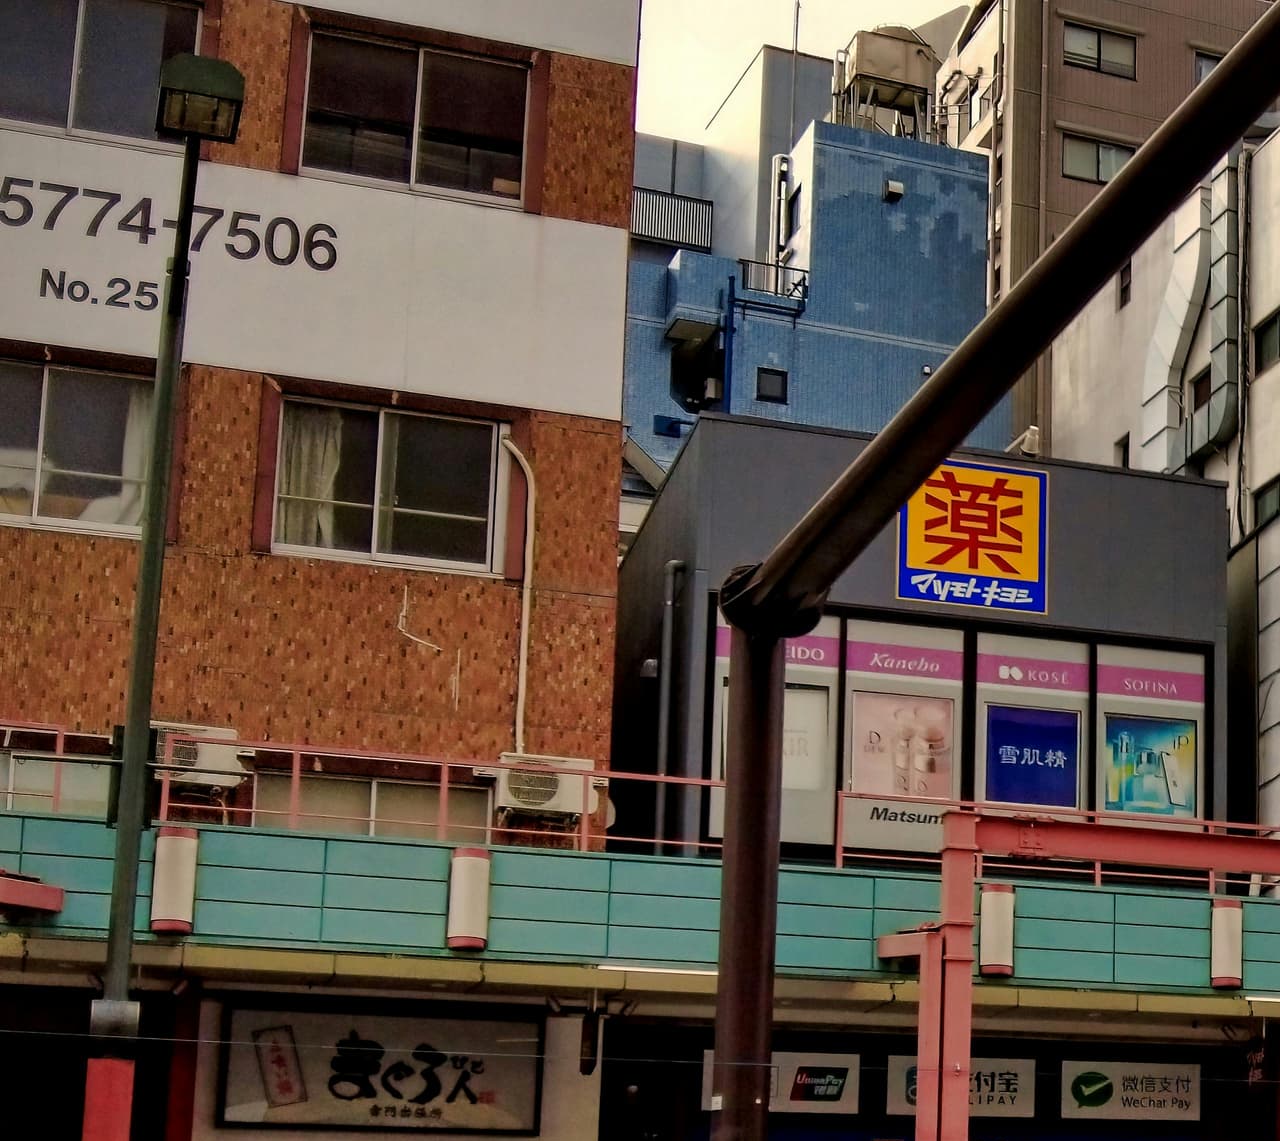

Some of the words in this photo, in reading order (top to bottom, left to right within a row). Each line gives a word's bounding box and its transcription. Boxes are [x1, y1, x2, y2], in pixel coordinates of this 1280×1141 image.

[39, 268, 159, 311] No.25
[924, 470, 1023, 575] 薬
[910, 573, 1033, 606] マツモトキヨシ
[869, 652, 940, 674] Kanebo
[1124, 677, 1178, 695] SOFINA
[999, 745, 1068, 770] 雪肌精
[1121, 1074, 1192, 1094] 微信支付
[968, 1095, 1017, 1105] LIPAY
[1121, 1096, 1166, 1108] WeChat
[1171, 1097, 1191, 1111] Pay
